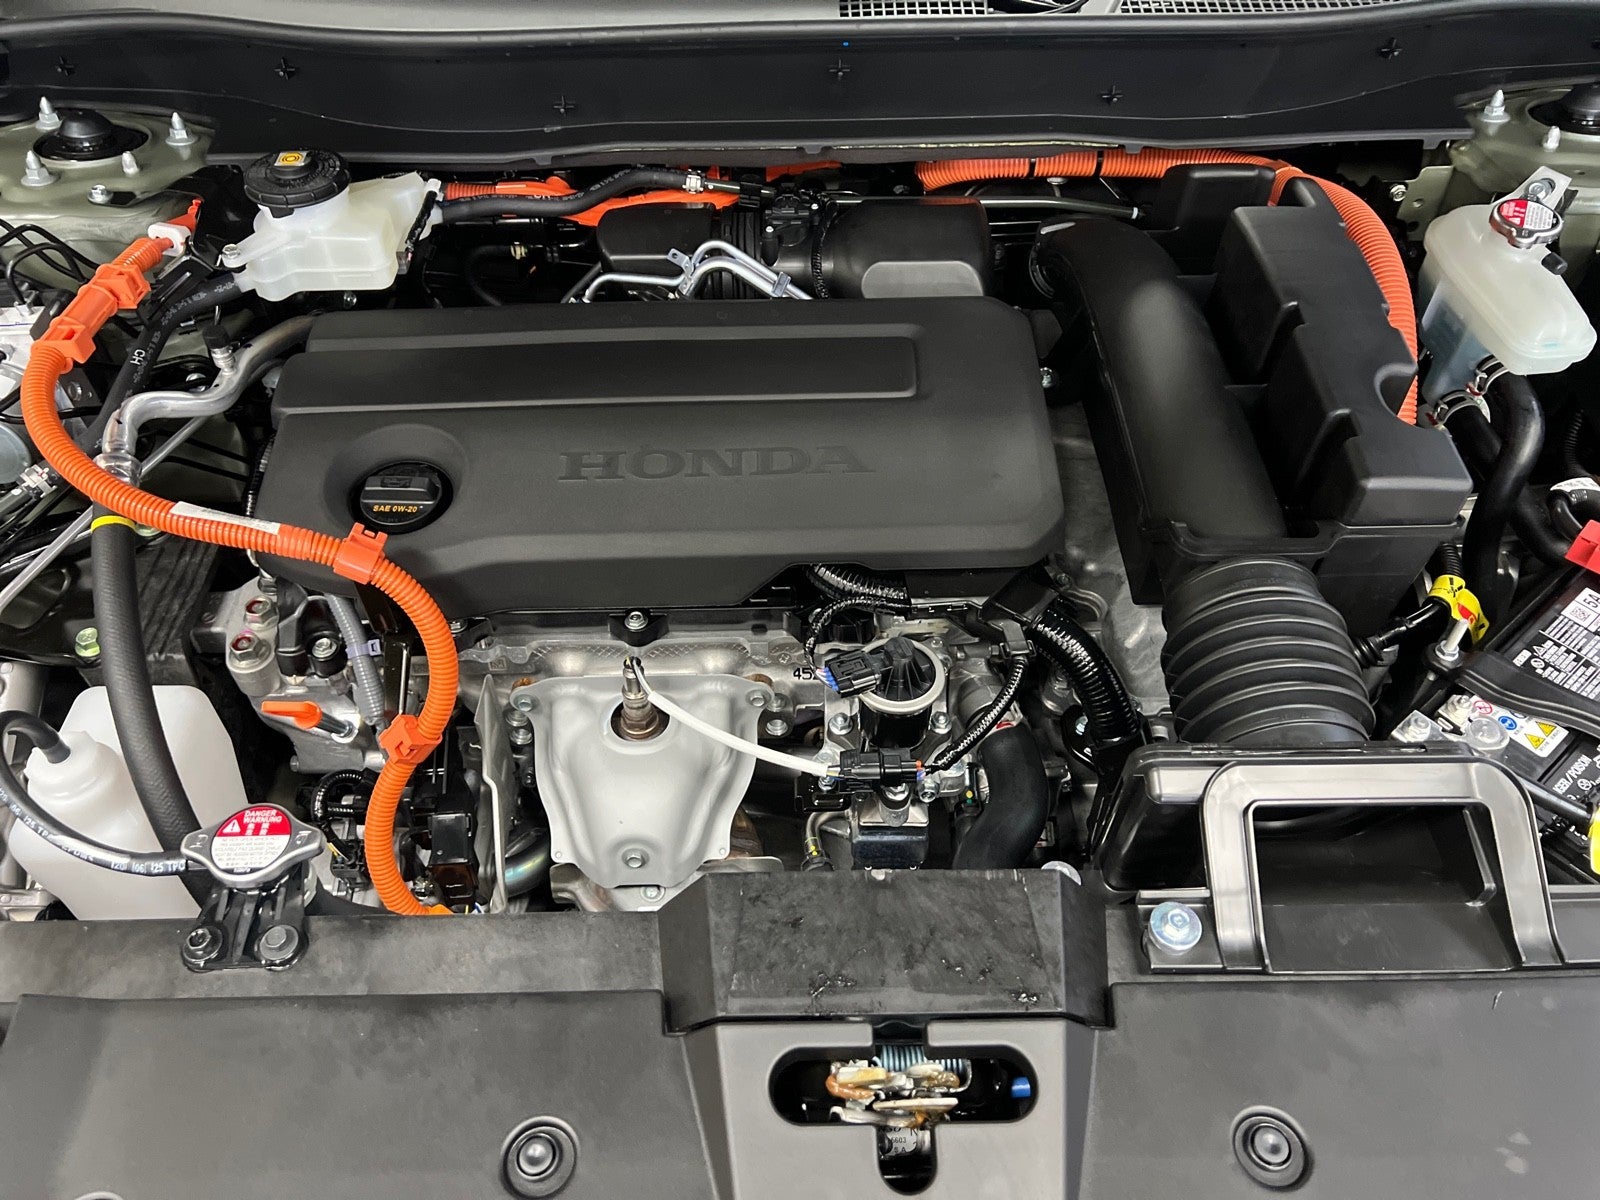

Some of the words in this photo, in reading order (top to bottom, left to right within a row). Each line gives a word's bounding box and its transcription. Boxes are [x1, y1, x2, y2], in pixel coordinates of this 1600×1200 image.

[130, 349, 146, 365] CH
[557, 446, 876, 481] HONDA
[392, 505, 418, 513] 0W-20
[793, 667, 817, 680] 45
[244, 809, 277, 817] DANGER
